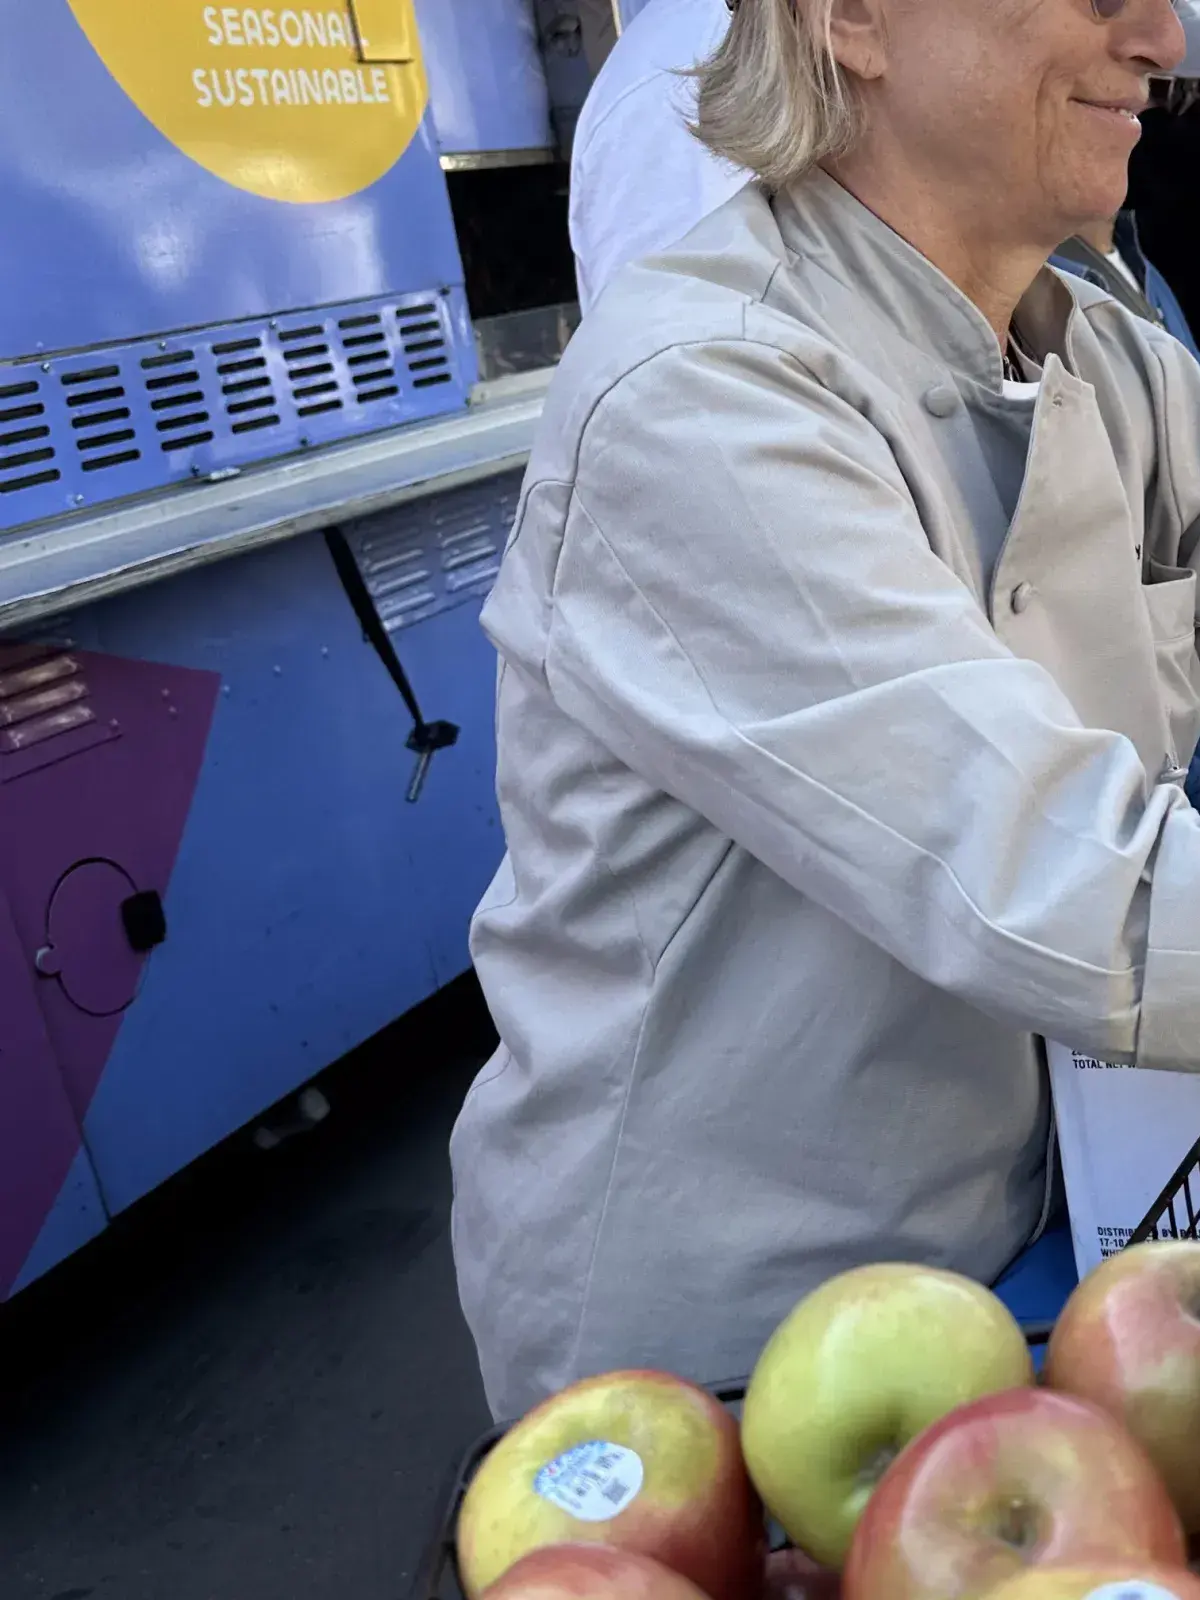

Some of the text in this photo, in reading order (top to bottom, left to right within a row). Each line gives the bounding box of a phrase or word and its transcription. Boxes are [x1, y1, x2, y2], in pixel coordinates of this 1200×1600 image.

[192, 67, 390, 108] SUSTAINABLE
[1072, 1058, 1103, 1069] TOTAL
[1099, 1238, 1124, 1248] 17-10
